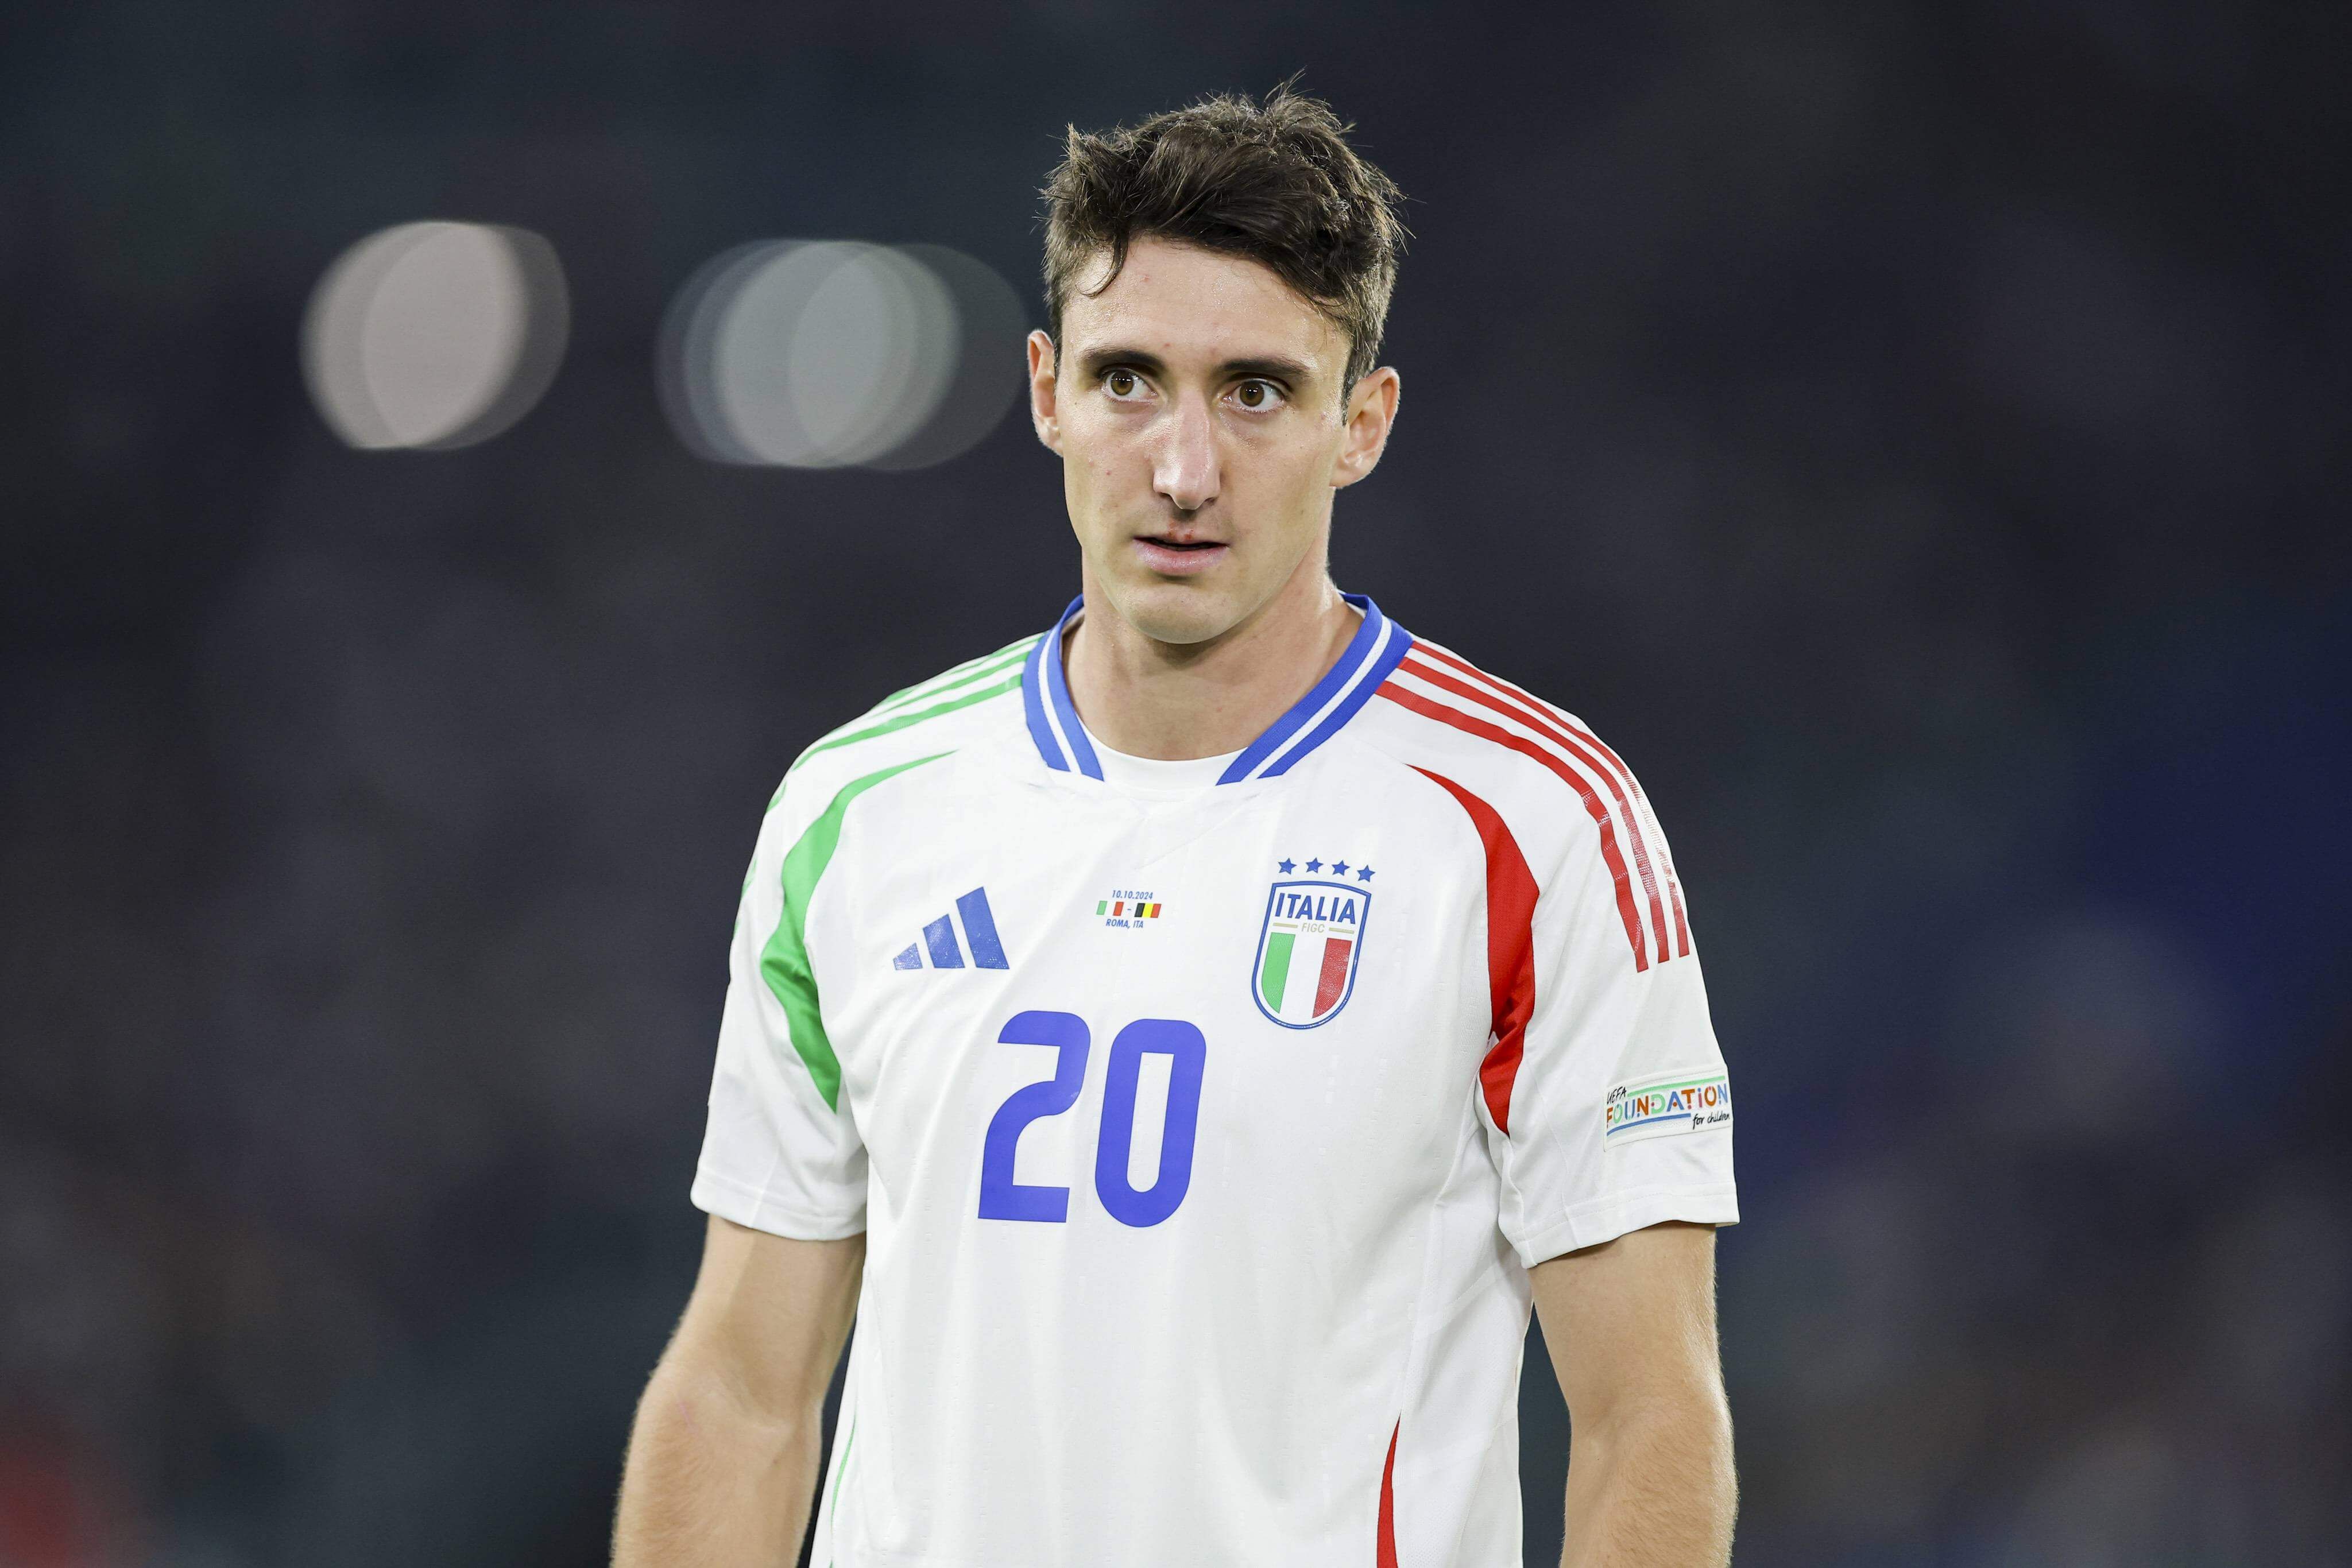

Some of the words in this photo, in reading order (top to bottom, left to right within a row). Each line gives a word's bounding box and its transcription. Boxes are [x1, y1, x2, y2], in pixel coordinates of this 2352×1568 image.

[1112, 890, 1153, 900] 10.10.2024
[1275, 893, 1356, 924] ITALIA
[1106, 919, 1130, 929] ROMA,
[1301, 923, 1325, 933] FIGC
[1607, 1086, 1627, 1105] UEFA
[978, 1011, 1206, 1228] 20
[1692, 1113, 1704, 1130] for
[1707, 1112, 1730, 1124] children
